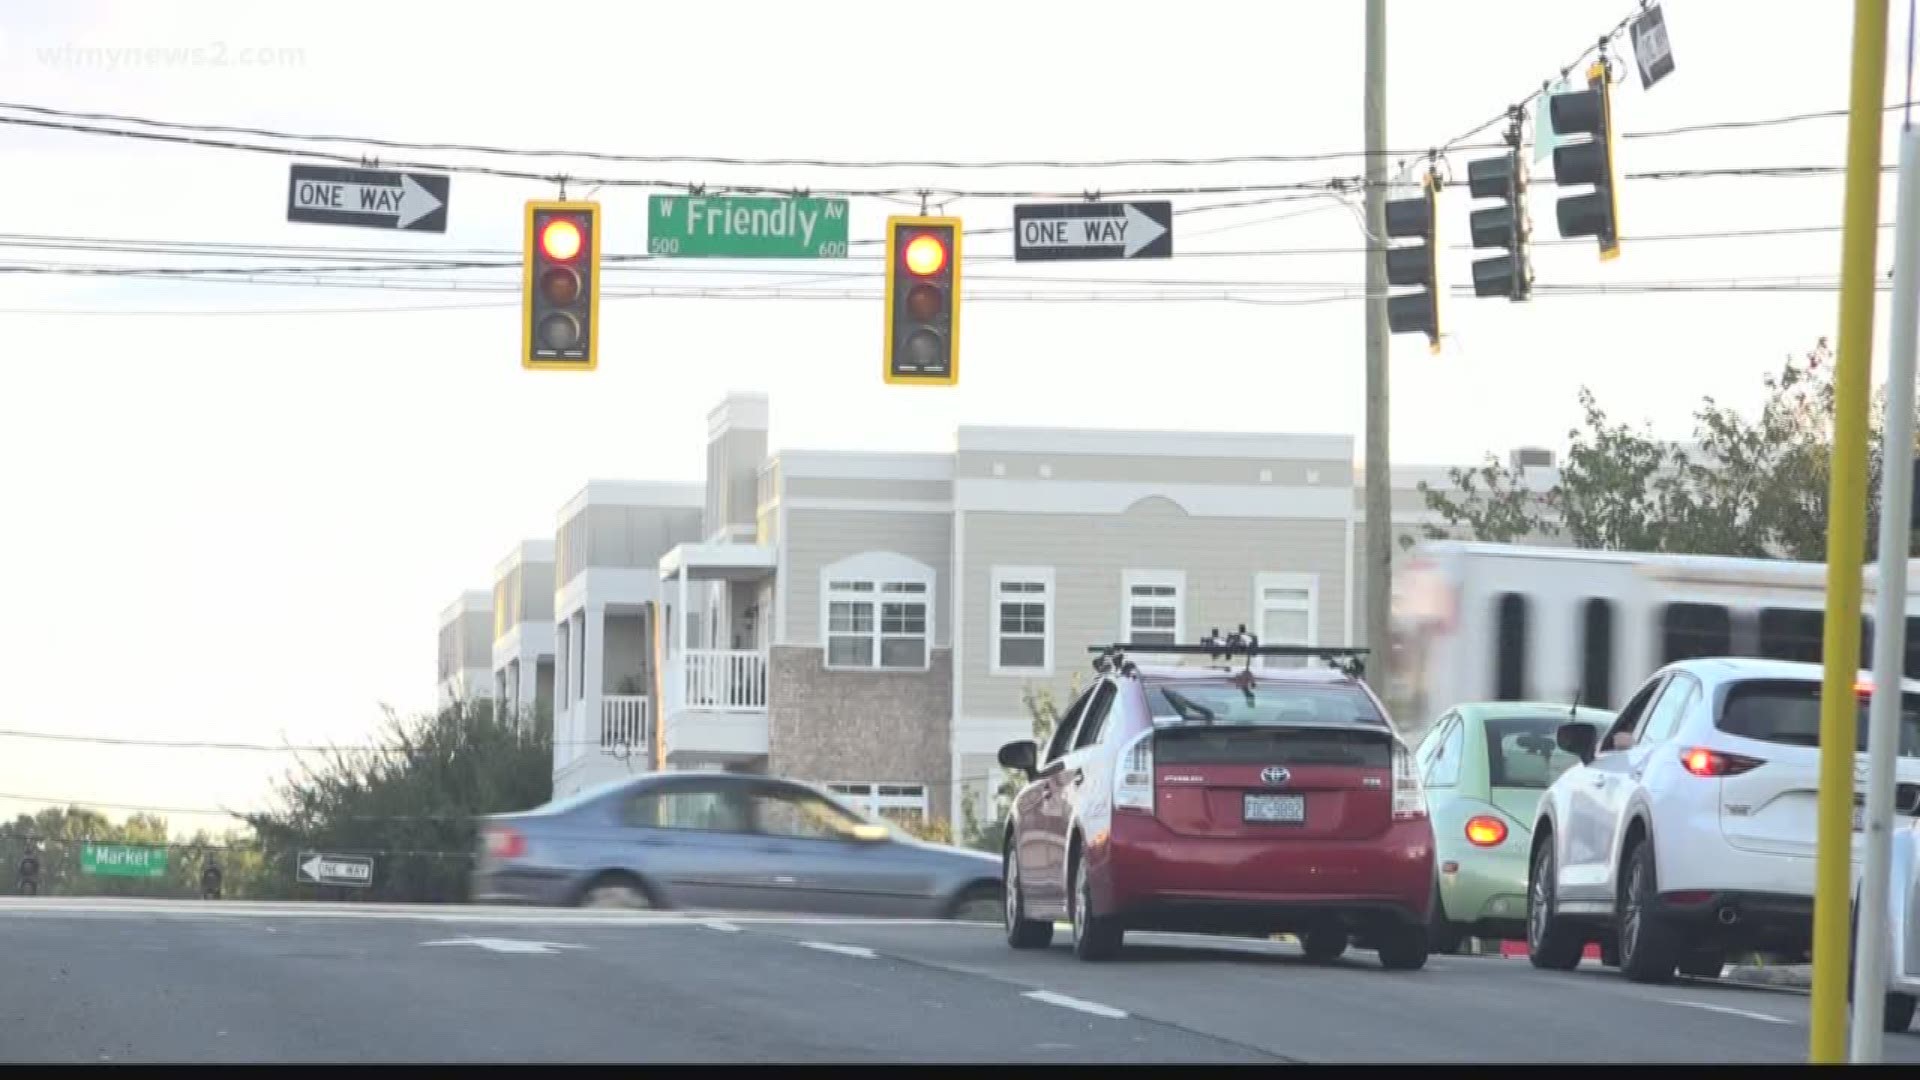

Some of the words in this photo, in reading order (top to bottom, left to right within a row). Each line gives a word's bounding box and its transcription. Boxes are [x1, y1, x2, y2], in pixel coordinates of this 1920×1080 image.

[300, 184, 343, 206] ONE
[360, 187, 405, 211] WAY
[660, 200, 673, 217] W
[687, 199, 818, 247] Friendly
[1025, 222, 1068, 243] ONE
[1085, 221, 1129, 242] WAY
[652, 239, 679, 253] 500
[819, 242, 845, 257] 600
[95, 846, 149, 866] Market
[345, 864, 367, 877] WAY
